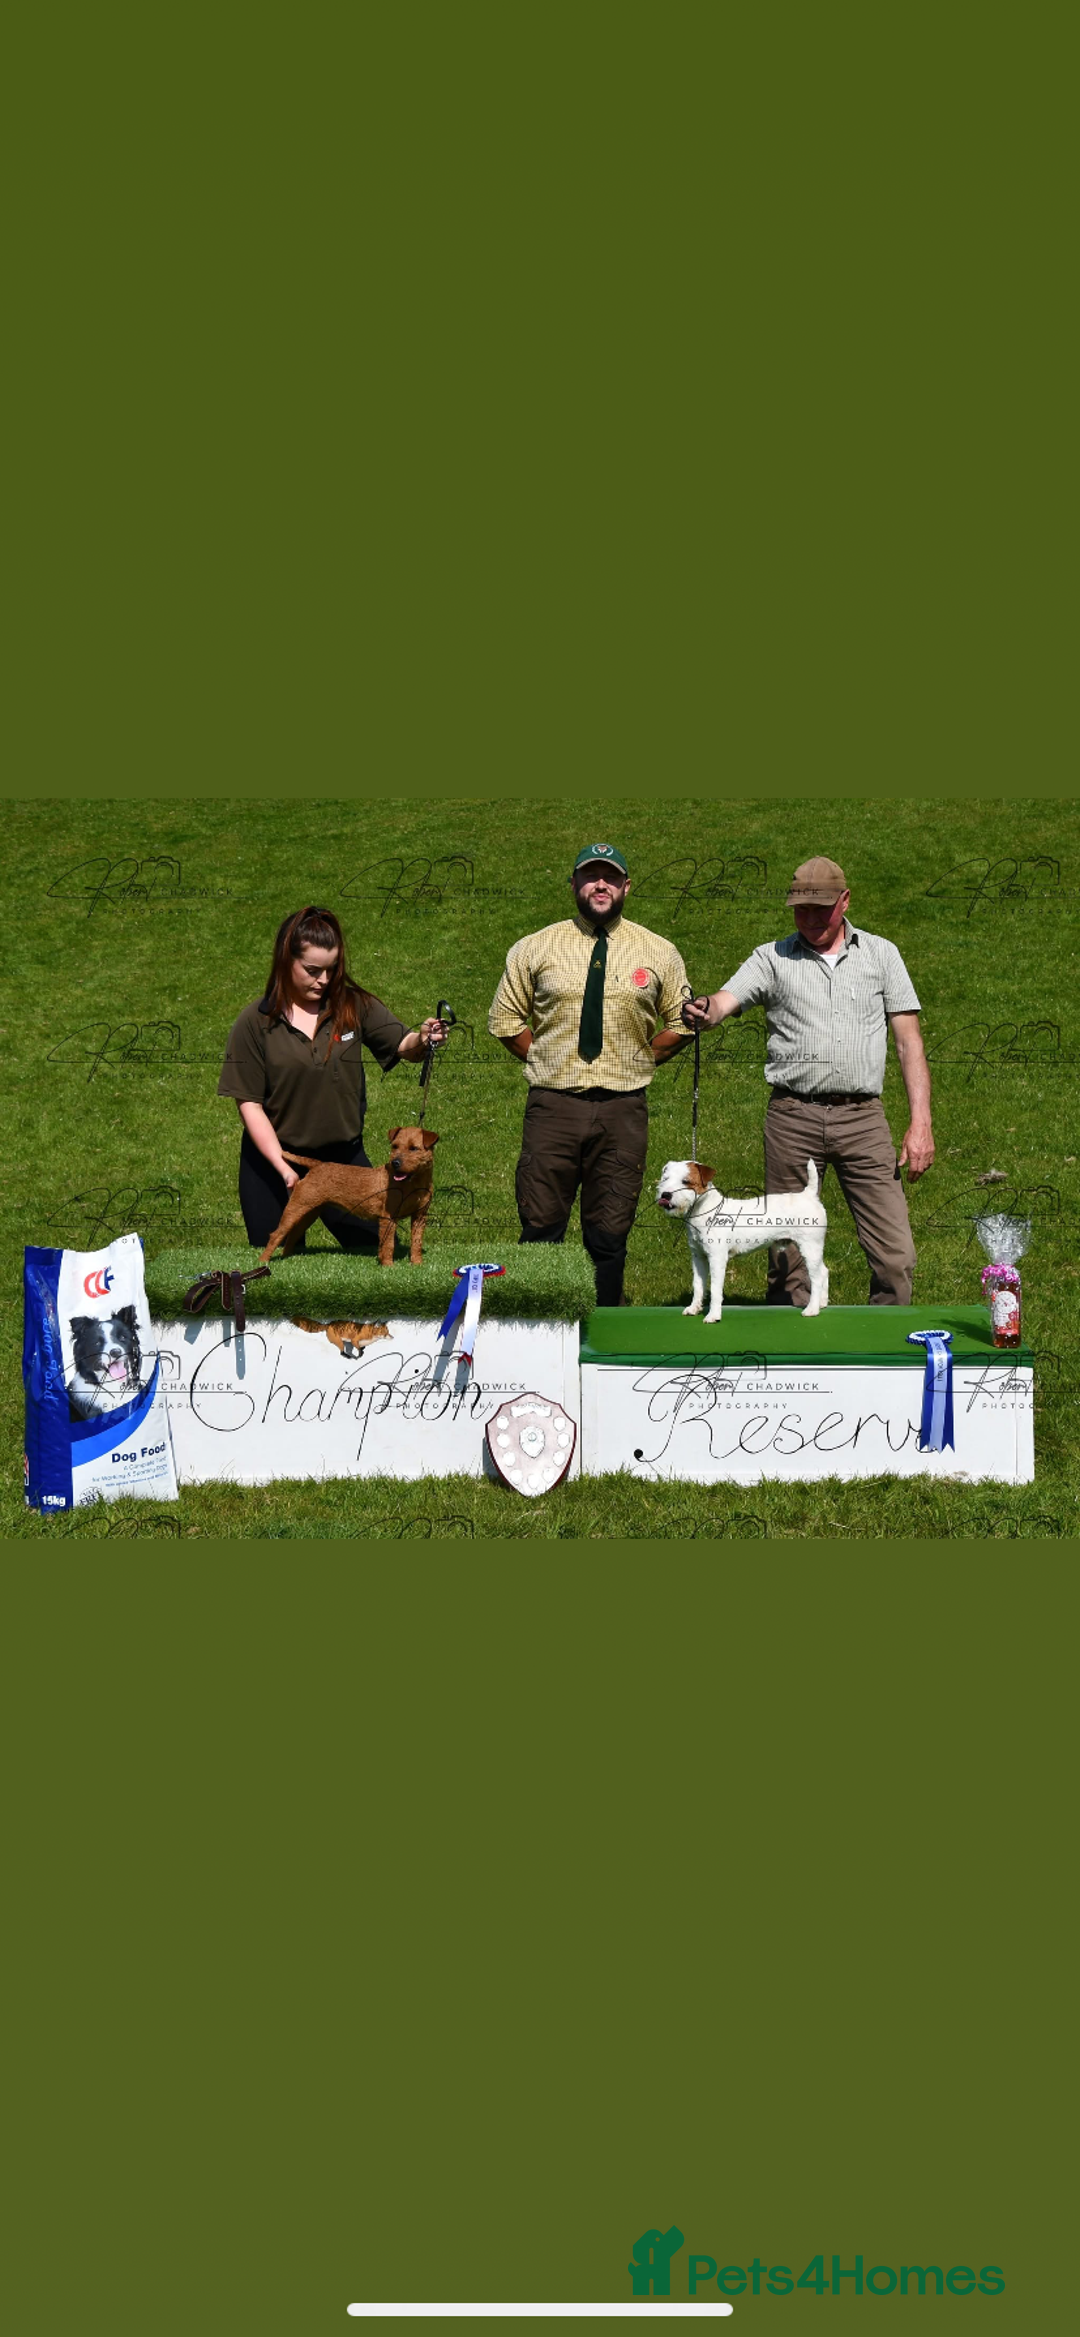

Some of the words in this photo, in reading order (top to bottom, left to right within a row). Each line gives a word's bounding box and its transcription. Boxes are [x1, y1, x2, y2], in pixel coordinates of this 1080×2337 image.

[84, 1266, 114, 1298] CCF
[189, 1332, 491, 1461] Champion
[112, 1452, 137, 1463] Dog
[141, 1442, 165, 1458] Food
[42, 1495, 66, 1507] 15kg
